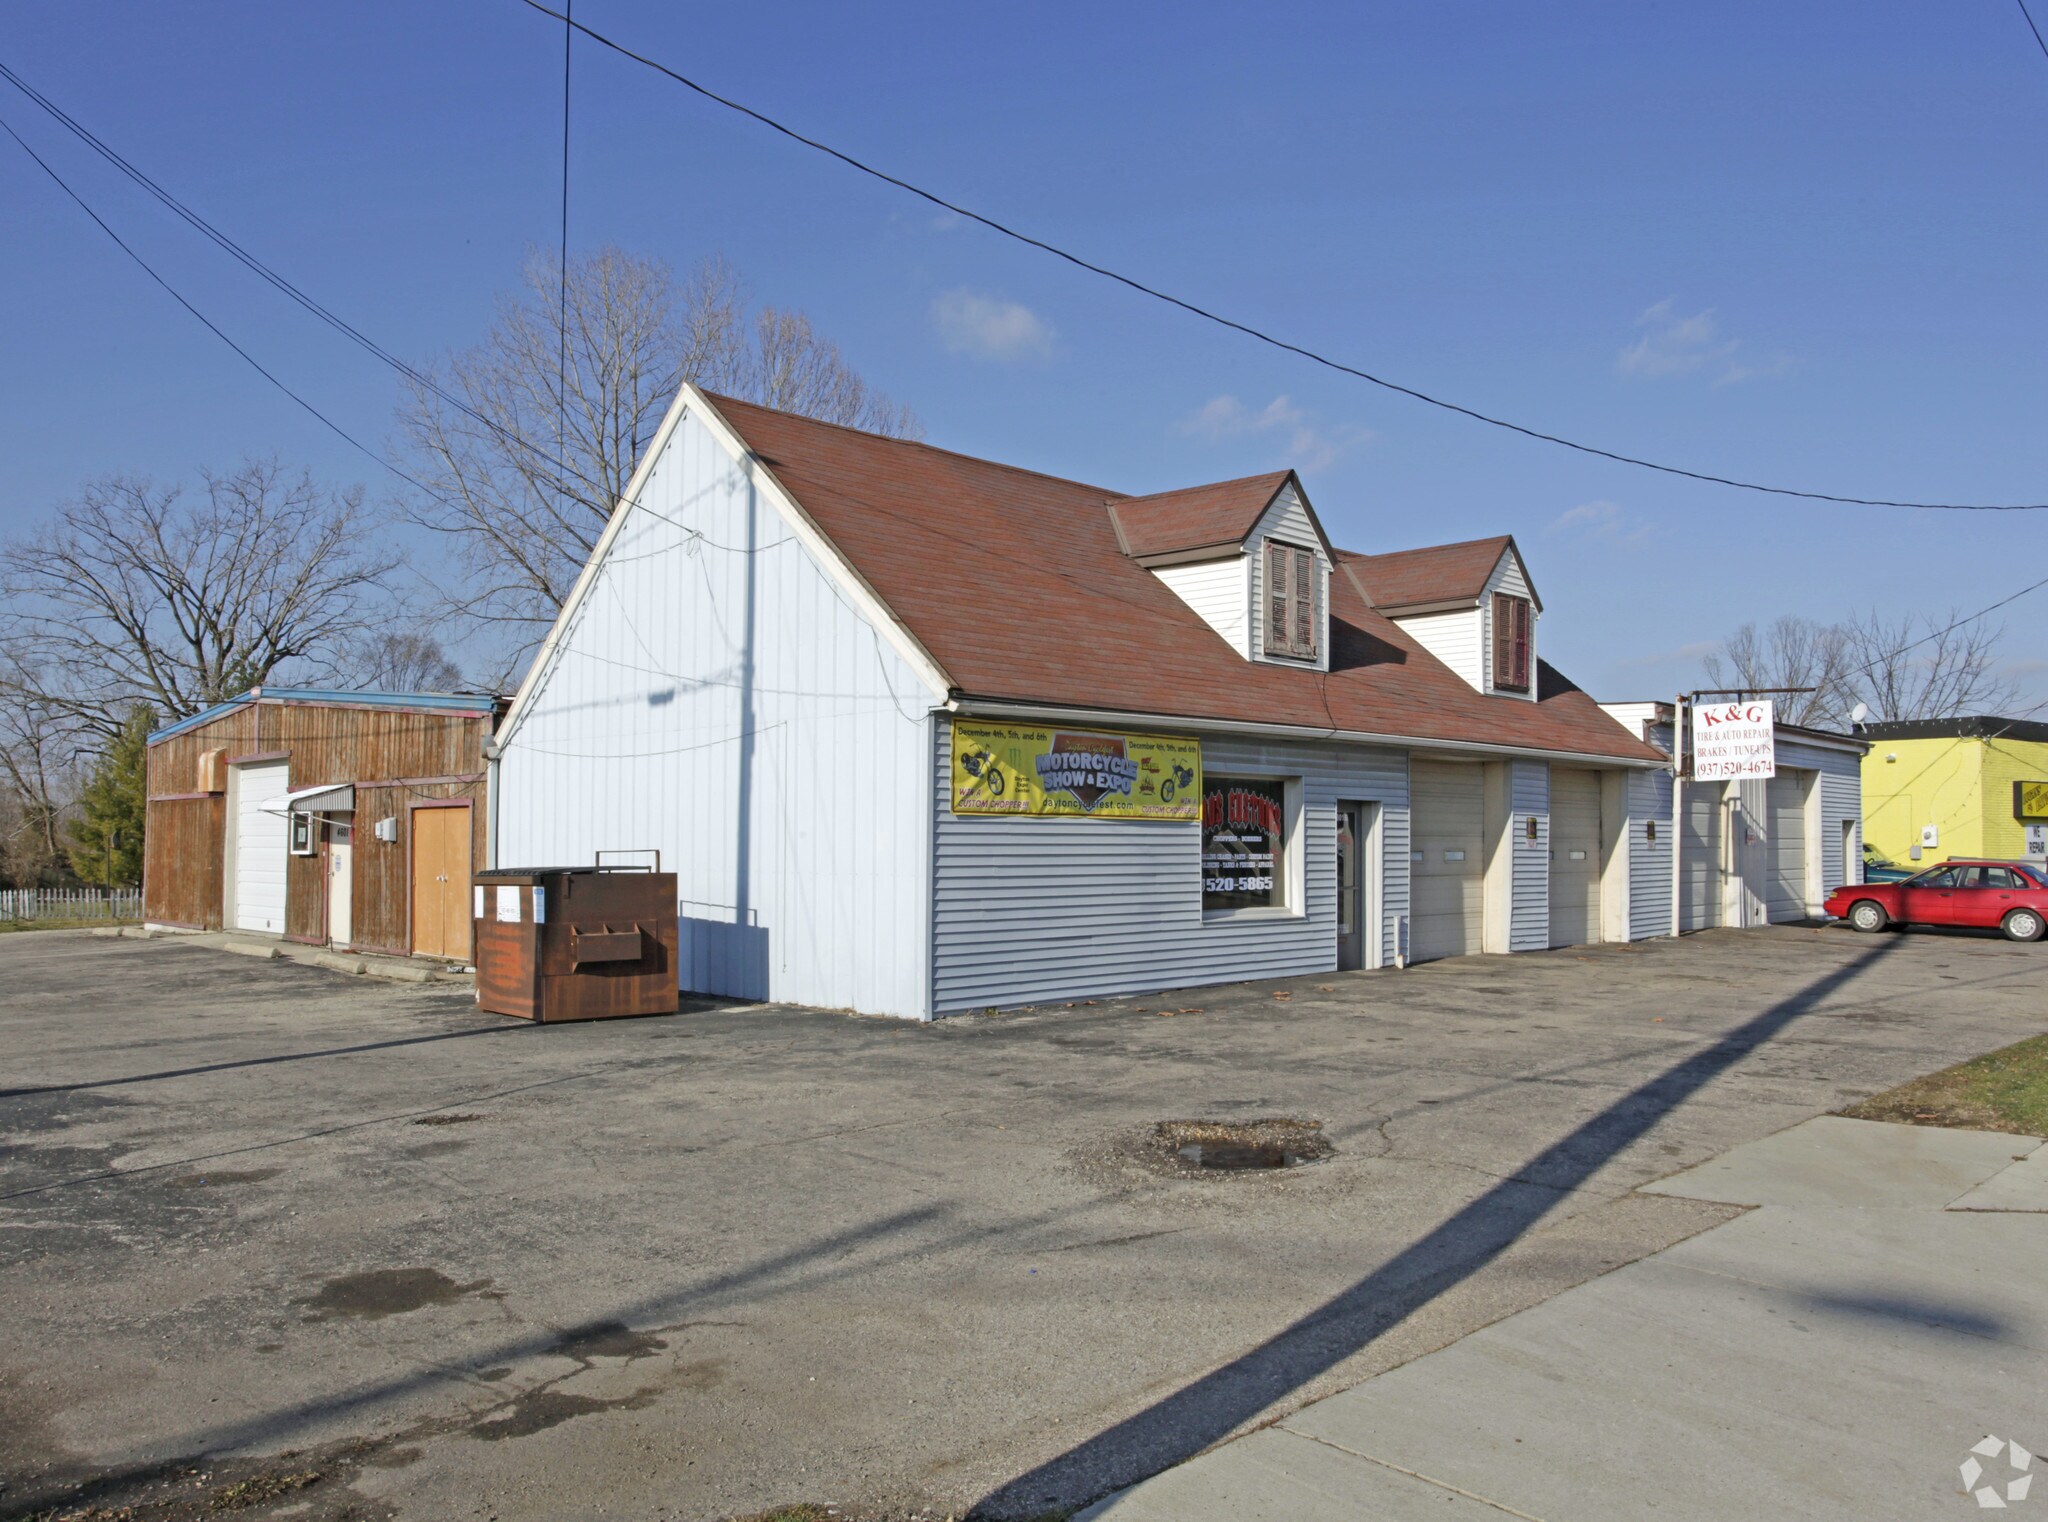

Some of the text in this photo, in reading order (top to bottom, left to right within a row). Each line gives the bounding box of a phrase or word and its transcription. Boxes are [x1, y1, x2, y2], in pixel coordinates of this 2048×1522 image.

[1704, 705, 1764, 727] K & G
[958, 727, 991, 737] December
[993, 729, 1006, 739] 4th,
[1022, 731, 1035, 741] and
[1036, 732, 1047, 741] 6th
[1697, 728, 1771, 742] TIRE & AUTO REPAIR
[1129, 741, 1155, 750] December
[1697, 746, 1727, 758] BRAKES
[1036, 752, 1138, 780] MOTORCYCLE
[1697, 760, 1772, 778] (937)520-4674
[1043, 771, 1086, 791] SHOW
[1087, 773, 1095, 785] &
[1096, 772, 1132, 795] EXPO
[960, 788, 982, 796] WIN A
[958, 799, 988, 808] CUSTOM
[1142, 805, 1165, 814] CUSTOM
[1228, 787, 1282, 840] CUSTOMS
[2032, 825, 2041, 838] WE
[2029, 841, 2045, 854] REPAIR
